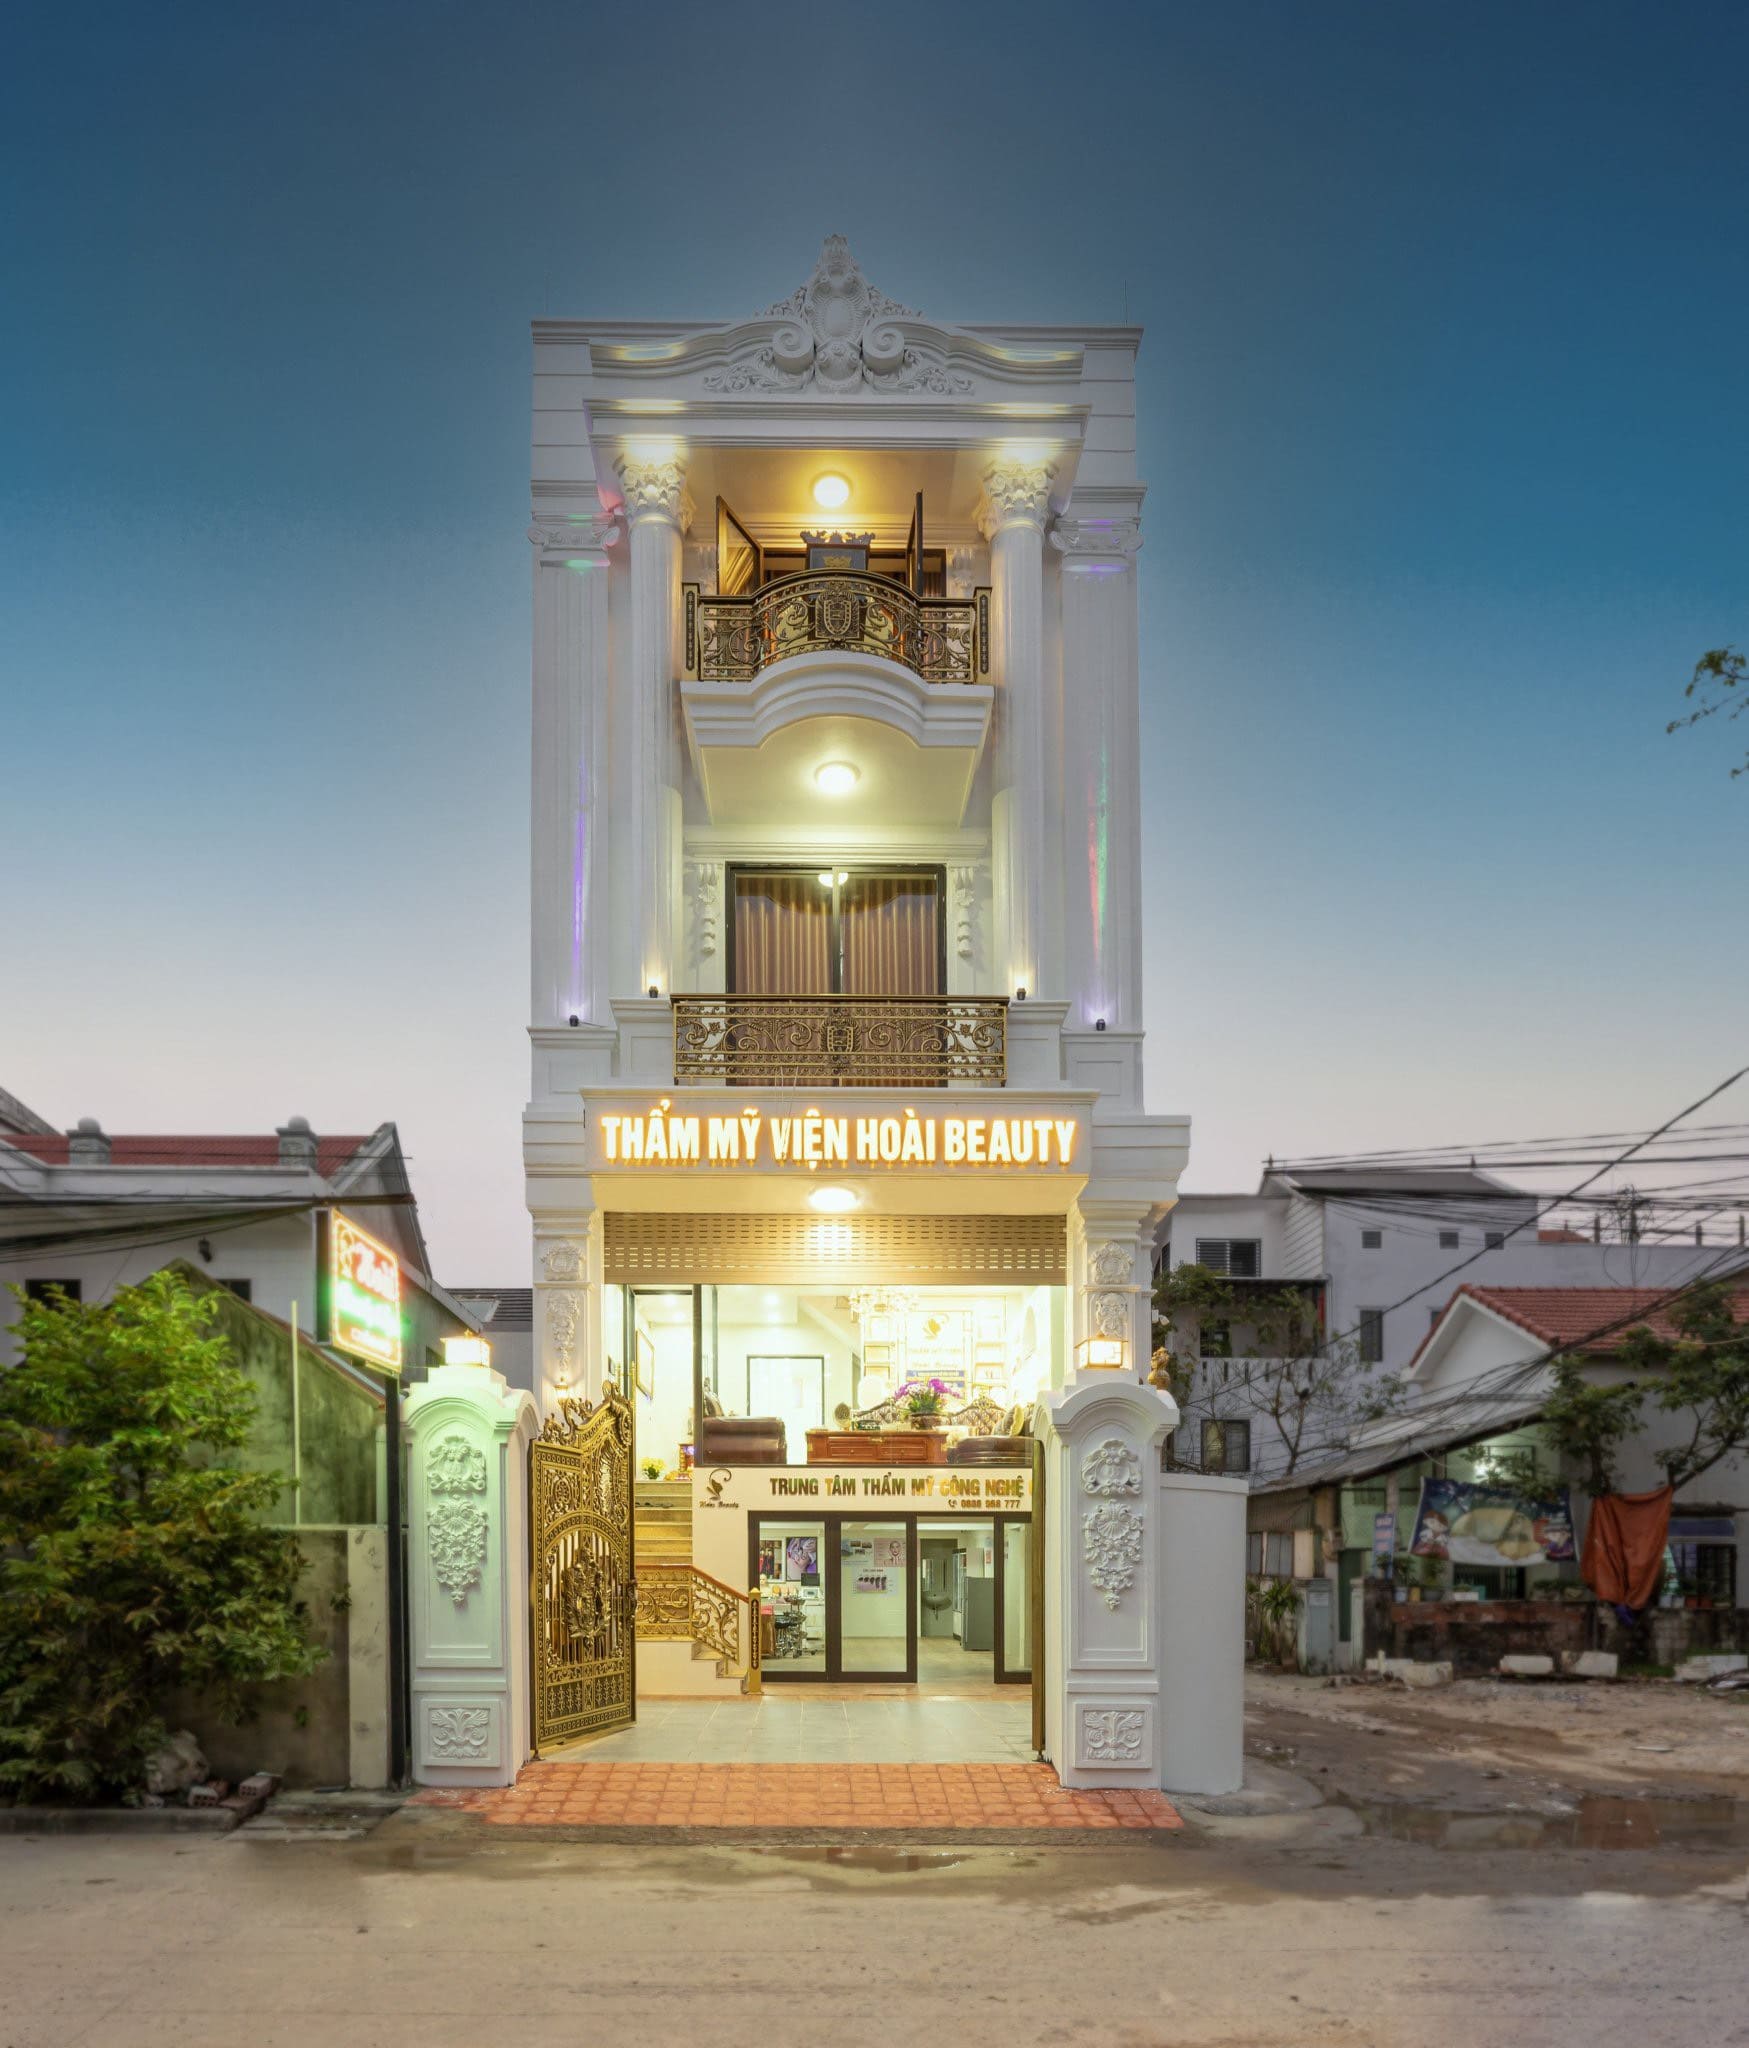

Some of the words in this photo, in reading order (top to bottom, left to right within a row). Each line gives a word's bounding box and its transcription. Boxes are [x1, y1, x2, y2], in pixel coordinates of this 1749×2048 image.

[601, 1098, 700, 1160] THẨM
[708, 1107, 759, 1160] MỸ
[770, 1108, 849, 1171] VIỆN
[856, 1108, 936, 1161] HOÀI
[944, 1118, 1076, 1163] BEAUTY
[769, 1478, 819, 1496] TRUNG
[824, 1474, 856, 1496] TÂM
[862, 1471, 906, 1496] THẨM
[911, 1475, 935, 1496] MỸ
[940, 1474, 980, 1496] CÔNG
[985, 1475, 1025, 1498] NGHỆ
[1004, 1499, 1021, 1509] 777
